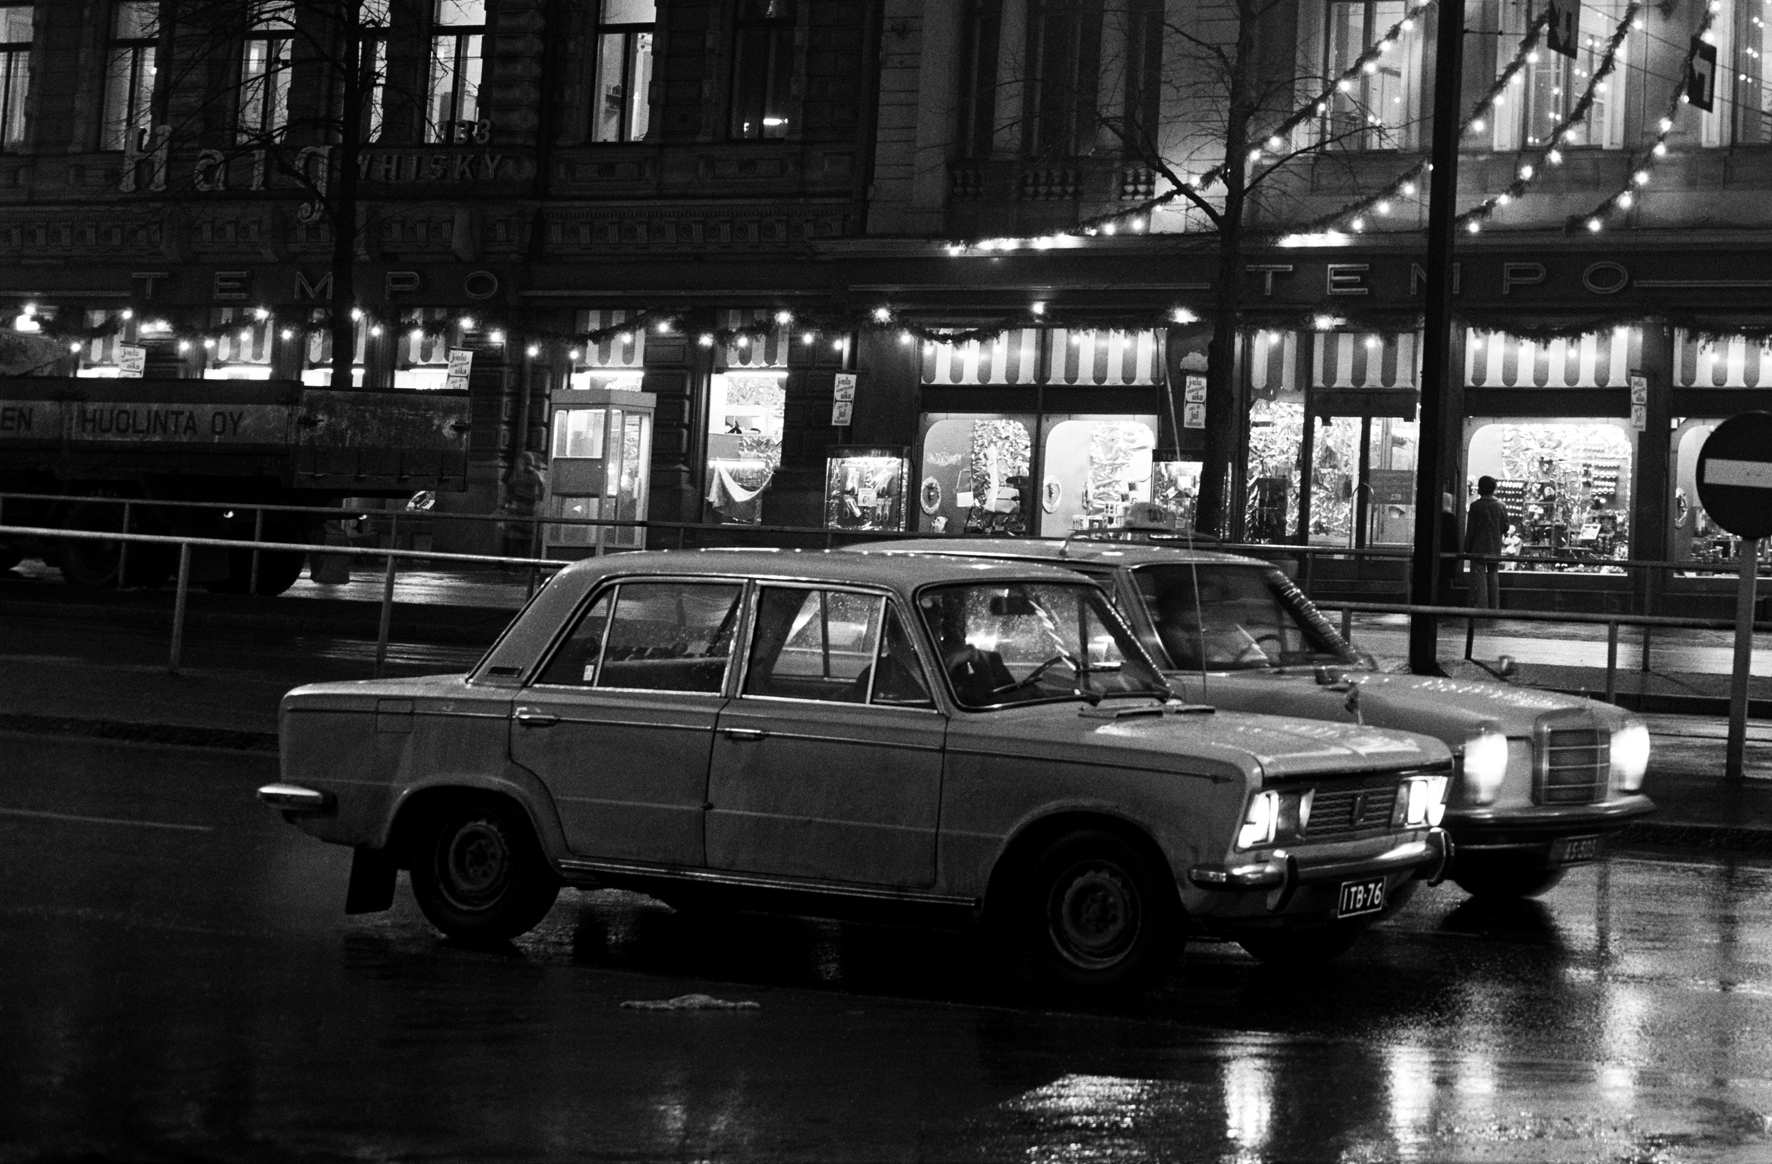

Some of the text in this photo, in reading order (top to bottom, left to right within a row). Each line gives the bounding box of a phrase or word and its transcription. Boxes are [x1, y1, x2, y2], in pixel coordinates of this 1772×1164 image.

[131, 271, 499, 300] TEMPO
[81, 408, 198, 435] HUOLINTA
[211, 411, 243, 436] OY
[1342, 881, 1383, 912] ITB-76
